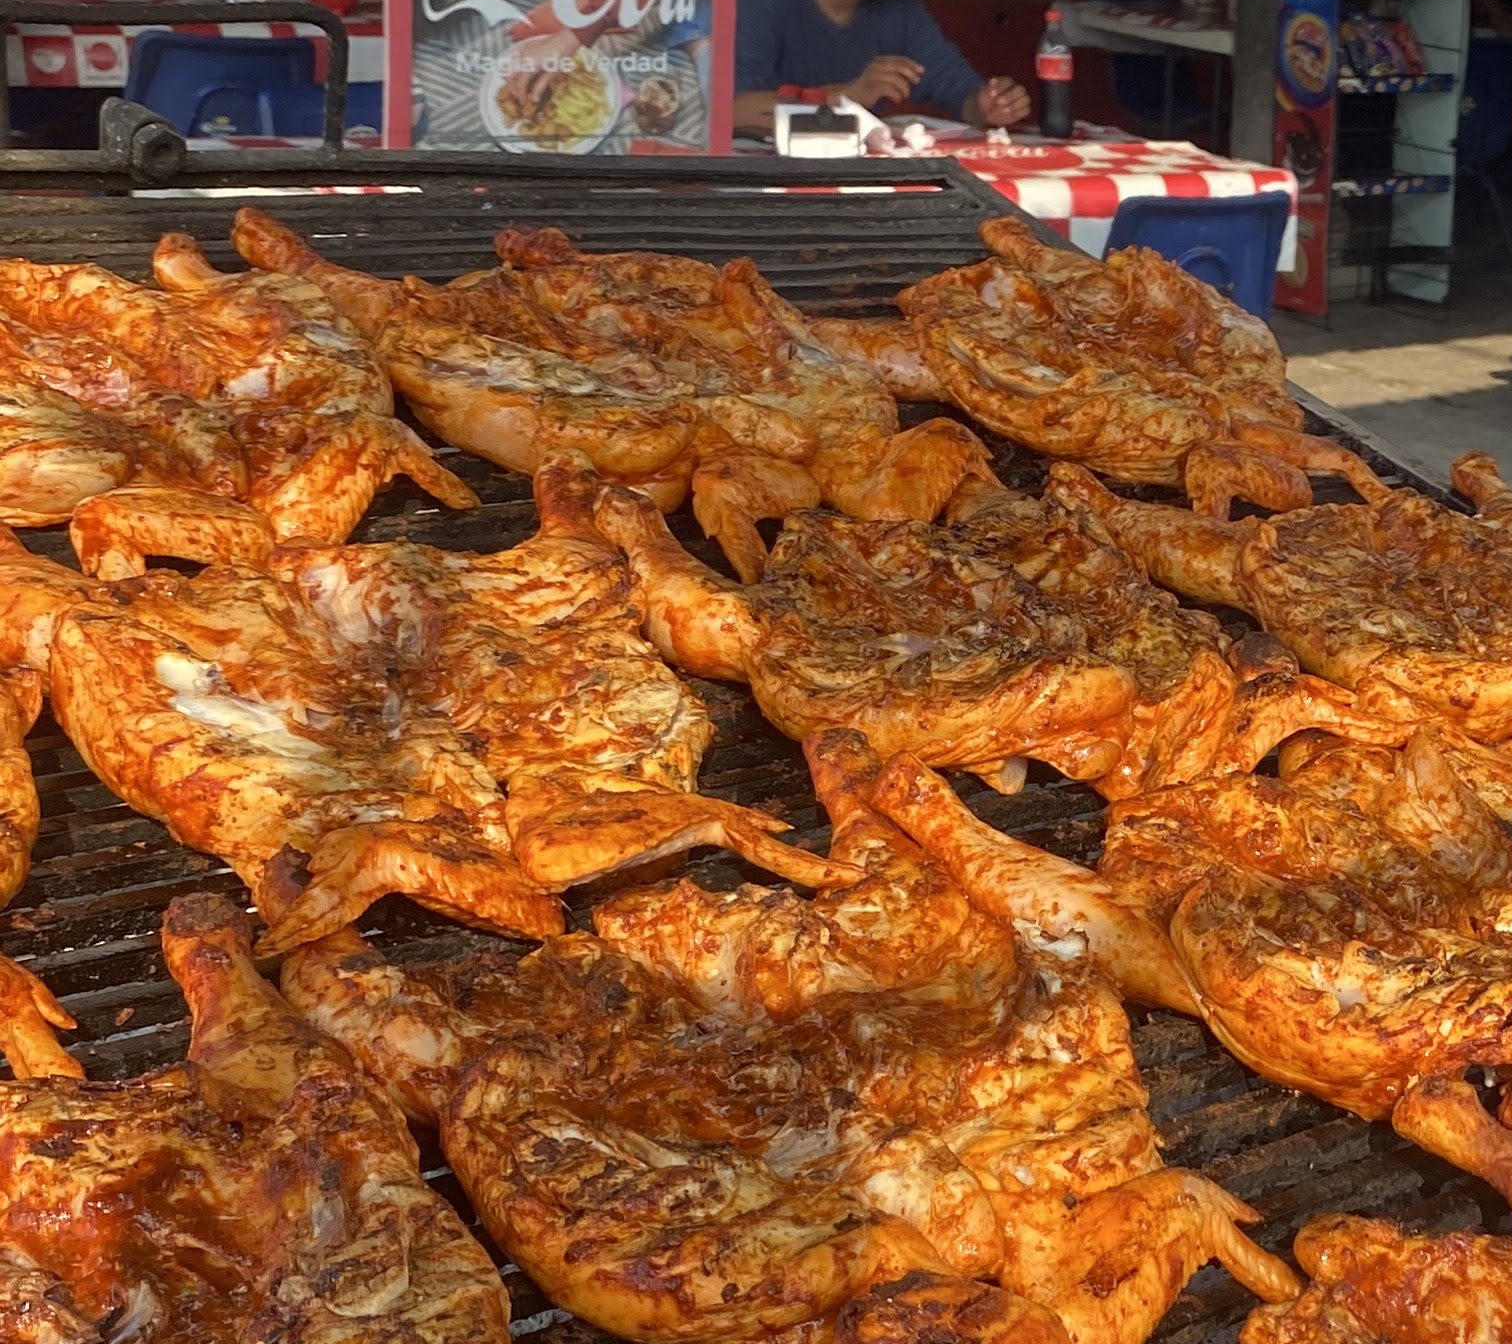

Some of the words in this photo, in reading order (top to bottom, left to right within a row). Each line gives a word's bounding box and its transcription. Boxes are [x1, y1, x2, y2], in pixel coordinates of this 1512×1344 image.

[455, 52, 538, 77] Magia
[541, 52, 576, 74] de
[582, 51, 670, 74] Verdad
